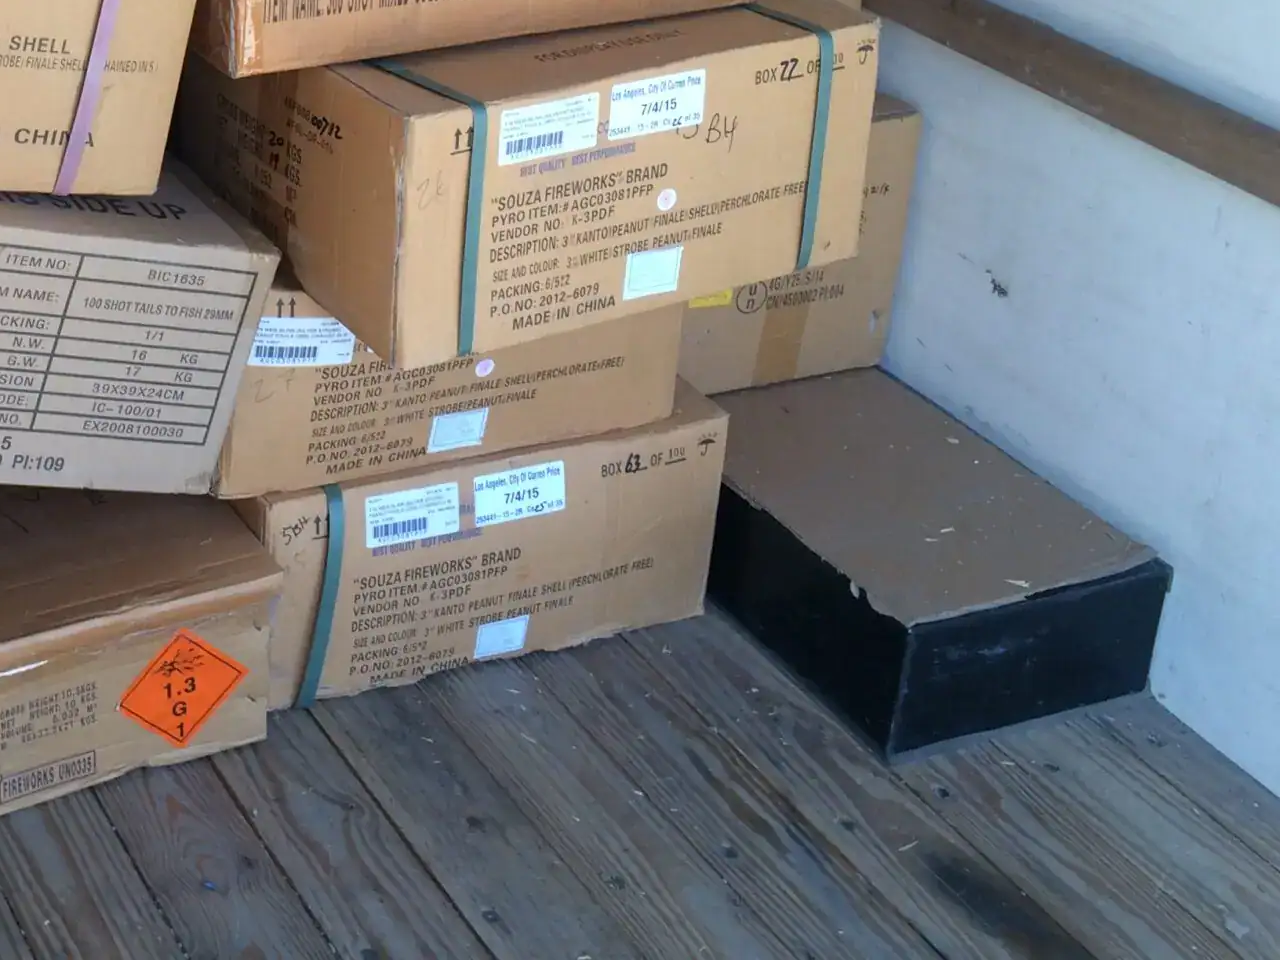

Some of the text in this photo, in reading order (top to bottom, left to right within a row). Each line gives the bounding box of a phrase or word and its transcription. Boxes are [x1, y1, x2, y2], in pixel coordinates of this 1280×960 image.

[8, 35, 71, 55] SHELL
[754, 66, 777, 85] BOX
[641, 98, 677, 116] 7/4/15
[626, 164, 668, 183] BRAND
[490, 225, 538, 243] VENDOR
[5, 253, 206, 288] ITEM BIC1635
[13, 287, 59, 303] NAME:
[103, 299, 131, 312] SHOT
[133, 301, 162, 315] TAILS
[512, 294, 616, 330] MADE CHINA
[180, 353, 198, 365] KG
[174, 371, 193, 383] KG
[504, 487, 539, 504] 7/4/15
[481, 547, 522, 565] BRAND
[164, 677, 196, 699] 1.3
[172, 702, 187, 717] G
[2, 769, 55, 798] FIREWORKS
